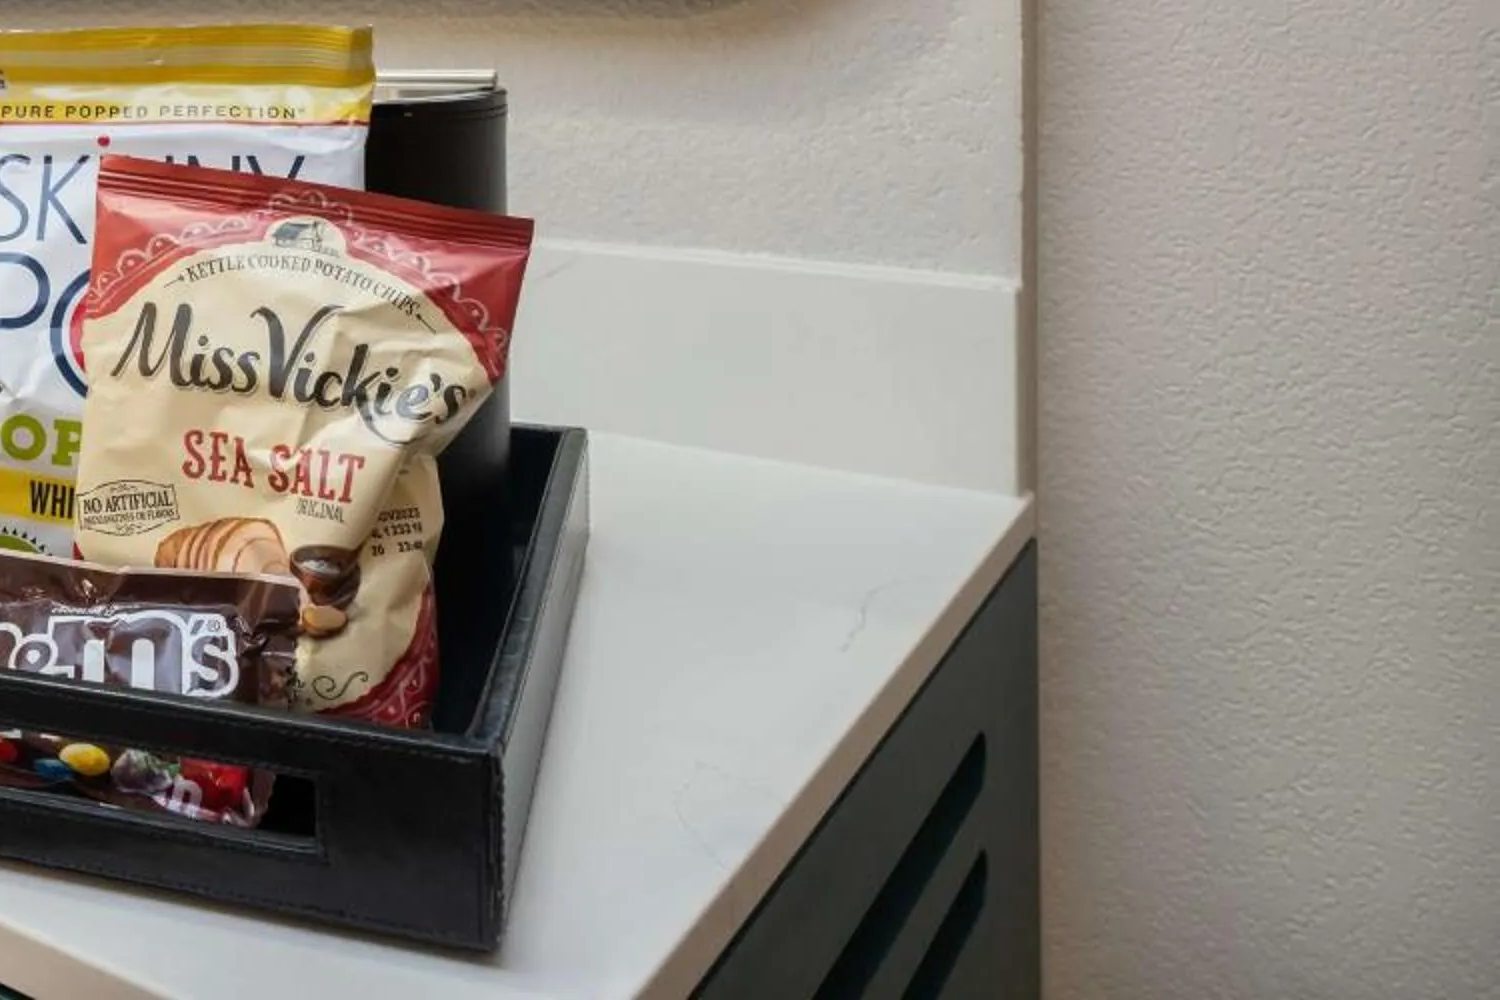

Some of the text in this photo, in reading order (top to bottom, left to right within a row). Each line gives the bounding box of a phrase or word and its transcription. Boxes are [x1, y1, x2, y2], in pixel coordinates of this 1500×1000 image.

[1, 104, 296, 120] PURE POPPED PERFECTION
[186, 254, 419, 318] KETTLE COOKED POTATO CHIPS
[110, 301, 262, 393] Miss
[249, 303, 468, 445] Vickie's
[181, 430, 366, 504] SEA SALT
[83, 489, 173, 515] NO ARTIFICIAL
